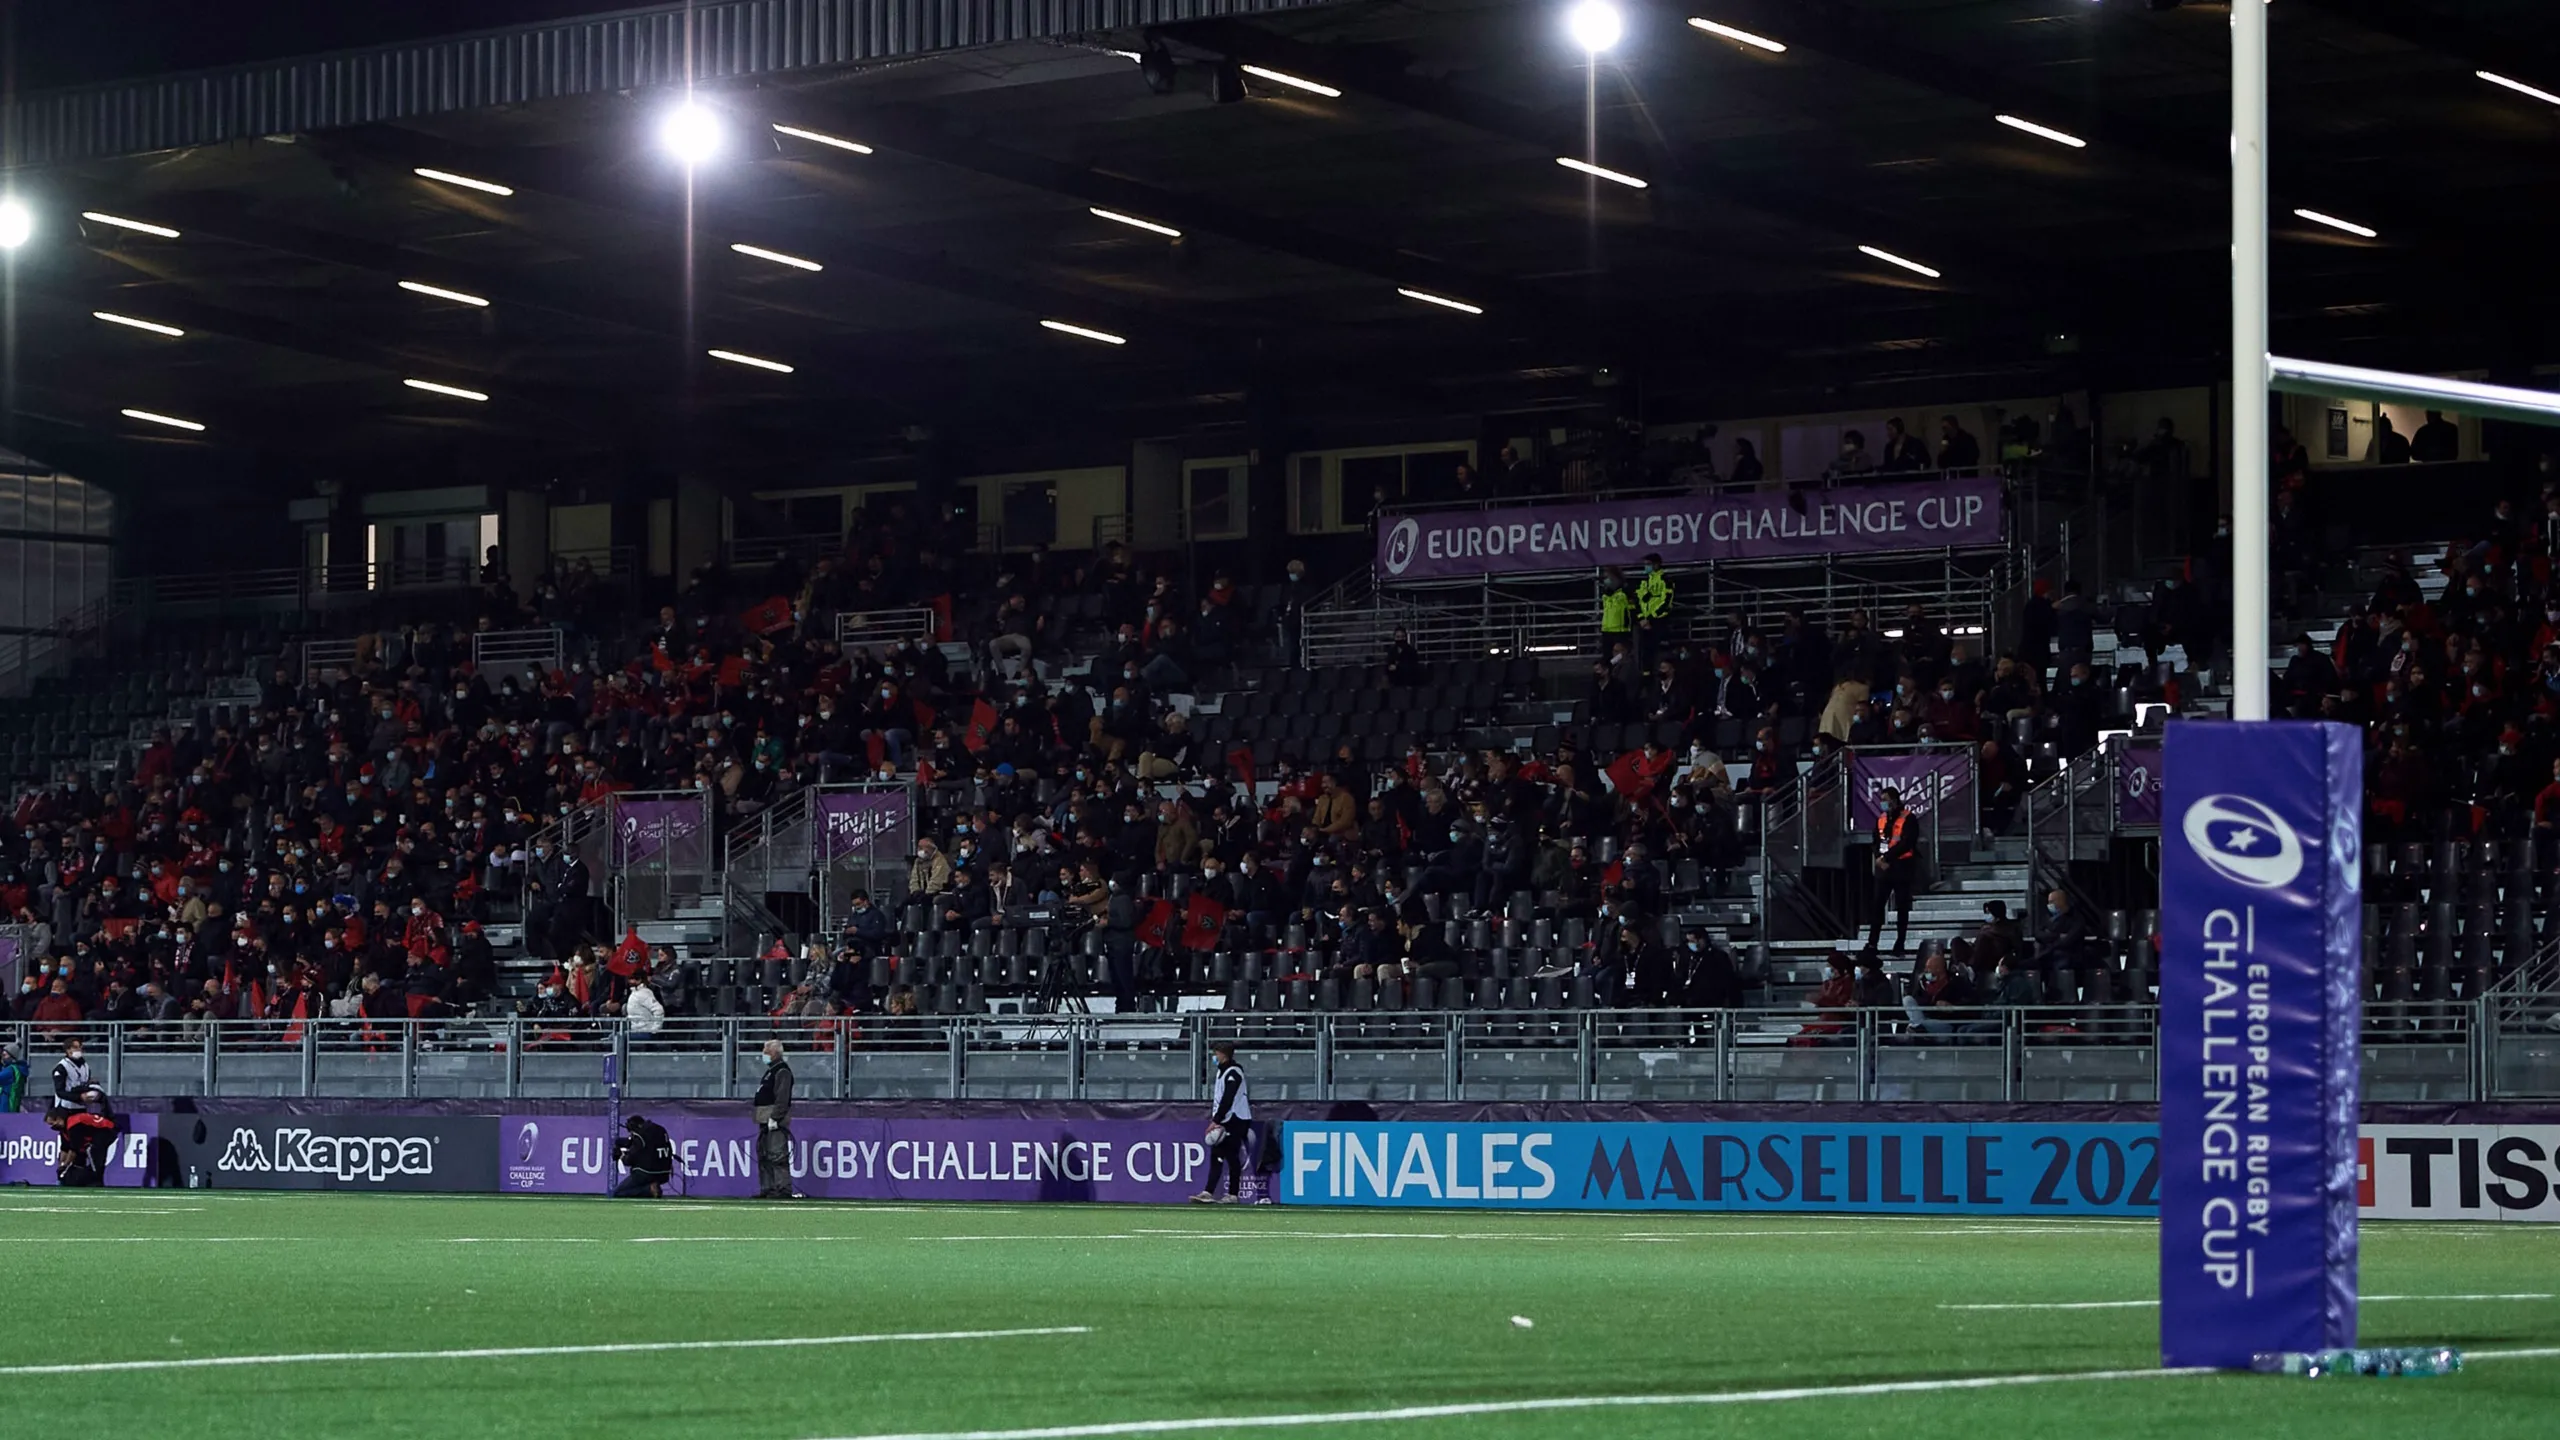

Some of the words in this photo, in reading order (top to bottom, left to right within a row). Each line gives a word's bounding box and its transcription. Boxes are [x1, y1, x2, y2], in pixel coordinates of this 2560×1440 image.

[1427, 519, 1590, 559] EUROPEAN
[1600, 512, 1703, 549] RUGBY
[1709, 501, 1908, 542] CHALLENGE
[1917, 495, 1983, 530] CUP
[2202, 908, 2240, 1183] CHALLENGE
[2246, 963, 2270, 1123] EUROPEAN
[0, 1135, 62, 1166] upRug
[275, 1128, 433, 1182] Kappa
[509, 1172, 546, 1180] CHALLENGE
[561, 1137, 751, 1177] EUEAN
[788, 1140, 880, 1179] UGBY
[886, 1141, 1114, 1182] CHALLENGE
[1126, 1141, 1206, 1183] CUP
[1292, 1132, 1556, 1200] FINALES
[1581, 1134, 2004, 1204] MARSEILLE
[2030, 1135, 2162, 1206] 202
[2386, 1136, 2560, 1210] TIS
[1223, 1181, 1268, 1190] CLLENGE
[2246, 1134, 2270, 1237] RUGBY
[2202, 1196, 2239, 1289] CUP
